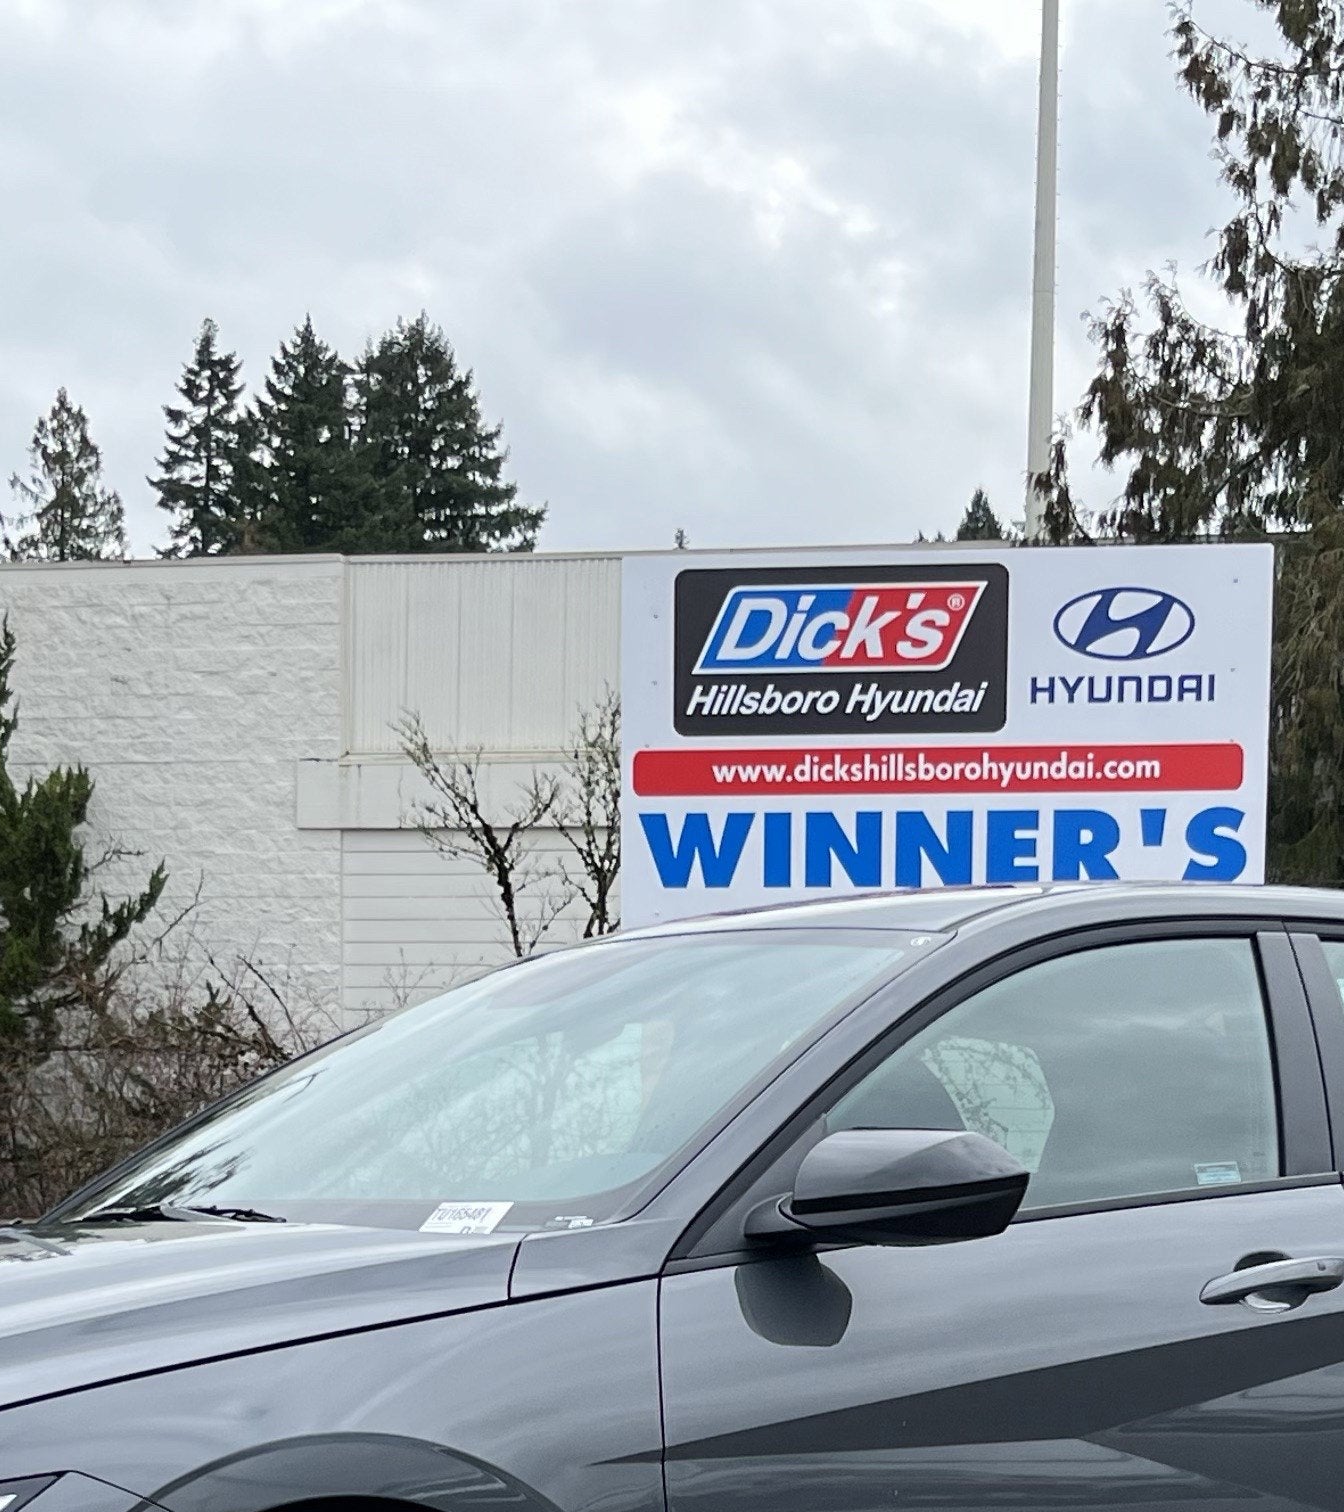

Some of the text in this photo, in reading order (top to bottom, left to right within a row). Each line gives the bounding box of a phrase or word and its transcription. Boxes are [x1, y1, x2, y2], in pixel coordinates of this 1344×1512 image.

[716, 591, 950, 662] Dick's
[685, 681, 989, 720] Hillsboro Hyundai
[1030, 673, 1215, 704] HYUNDAI
[712, 751, 1161, 788] www.dickshillsborohyundai.com
[639, 807, 1248, 888] WINNER'S
